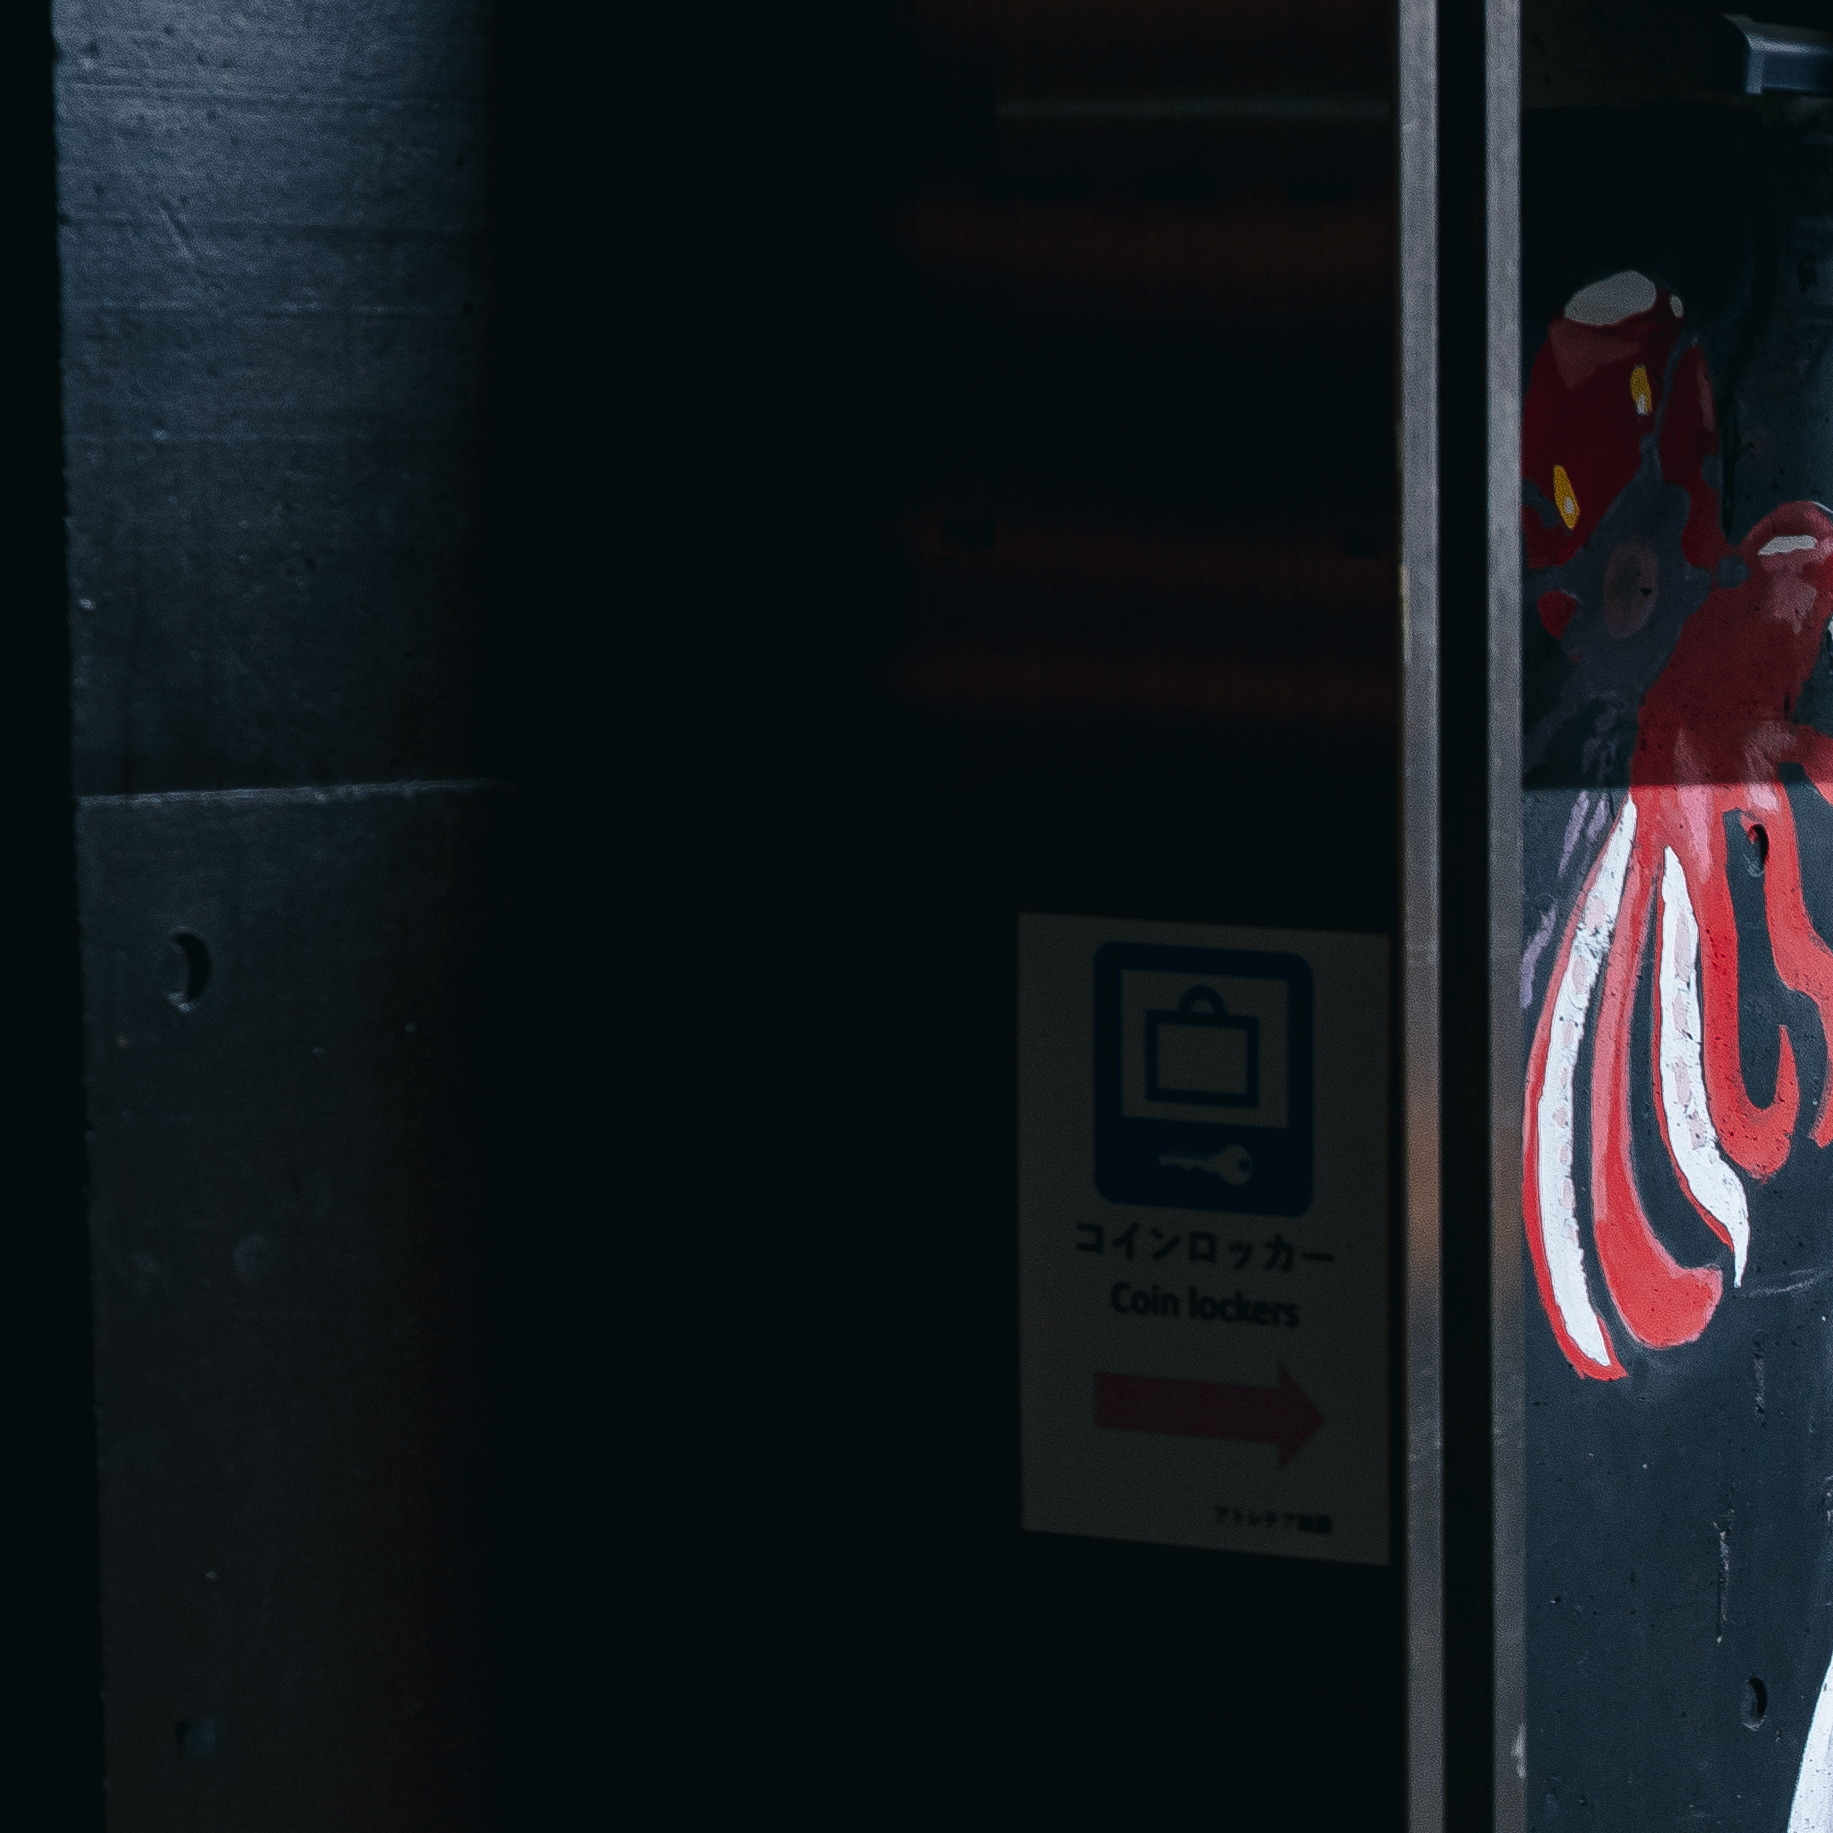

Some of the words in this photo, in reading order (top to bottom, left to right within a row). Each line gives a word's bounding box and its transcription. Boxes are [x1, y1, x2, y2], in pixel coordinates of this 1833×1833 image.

[1075, 1221, 1335, 1274] コインロッカー
[1110, 1280, 1180, 1317] Coin
[1189, 1286, 1301, 1330] lockers
